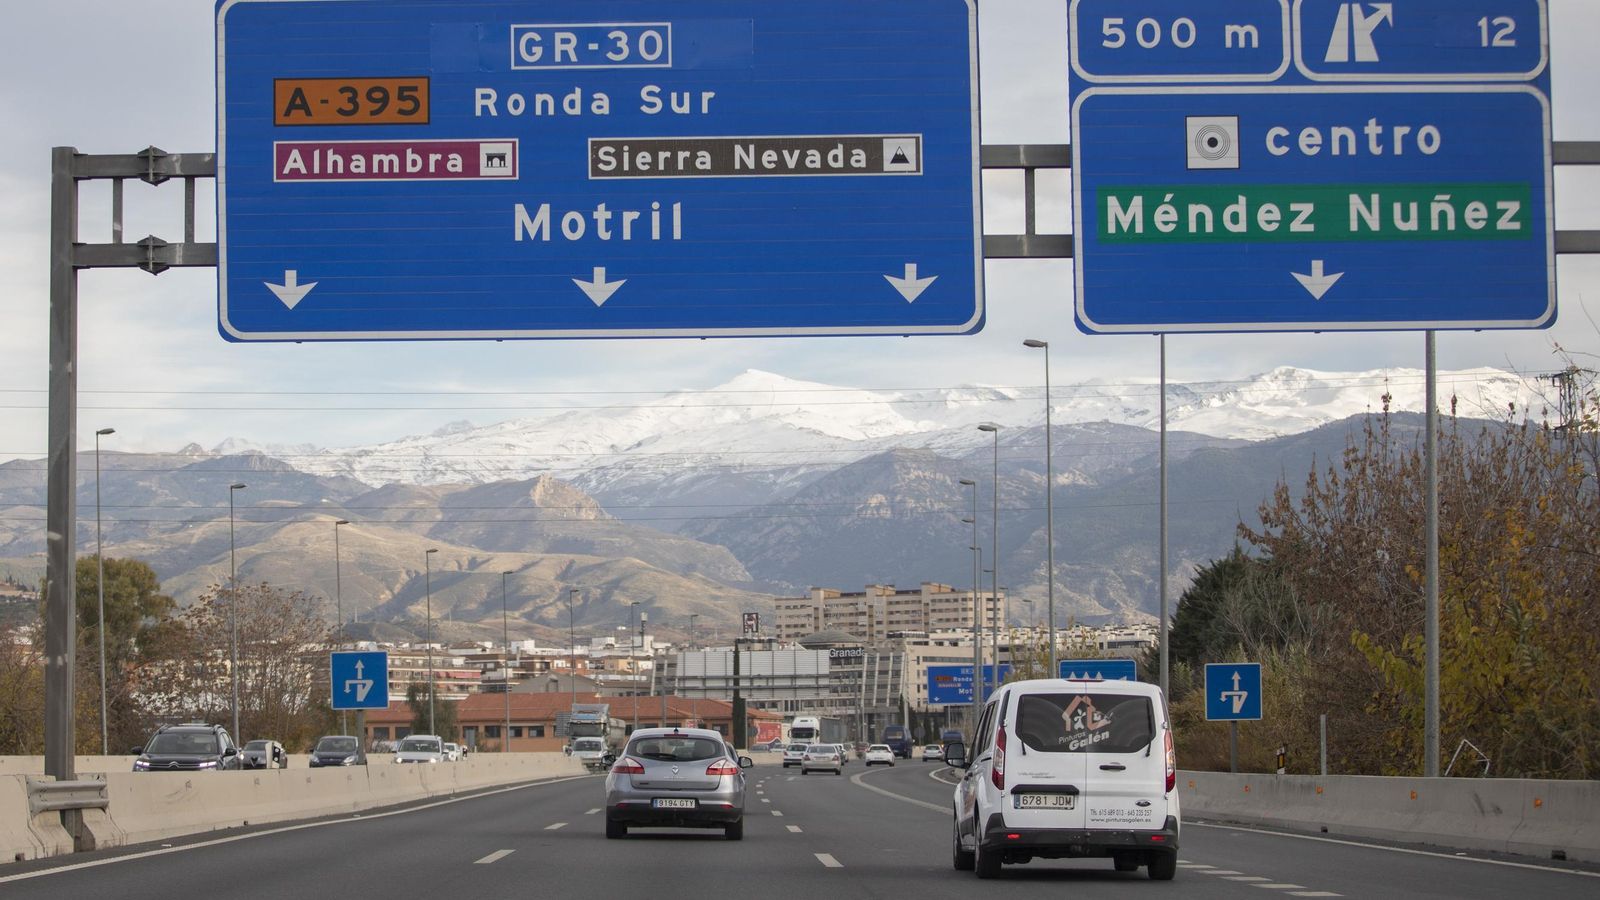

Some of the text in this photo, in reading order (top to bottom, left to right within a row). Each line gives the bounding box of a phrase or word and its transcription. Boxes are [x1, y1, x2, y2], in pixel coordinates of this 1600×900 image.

[1103, 18, 1258, 48] 500 m
[1478, 17, 1515, 46] 12
[518, 31, 664, 64] GR-30
[284, 86, 420, 117] A-395
[476, 85, 715, 116] Ronda Sur
[1266, 118, 1440, 155] centro
[283, 148, 462, 174] Alhambra
[598, 144, 866, 171] Sierra Nevada
[515, 202, 681, 241] Motril
[1108, 194, 1520, 233] Méndez Nuñez
[1058, 732, 1086, 744] Pinturas
[1069, 730, 1109, 751] Galén
[658, 799, 694, 807] 9194 GTY
[1022, 796, 1072, 806] 6781 JDM
